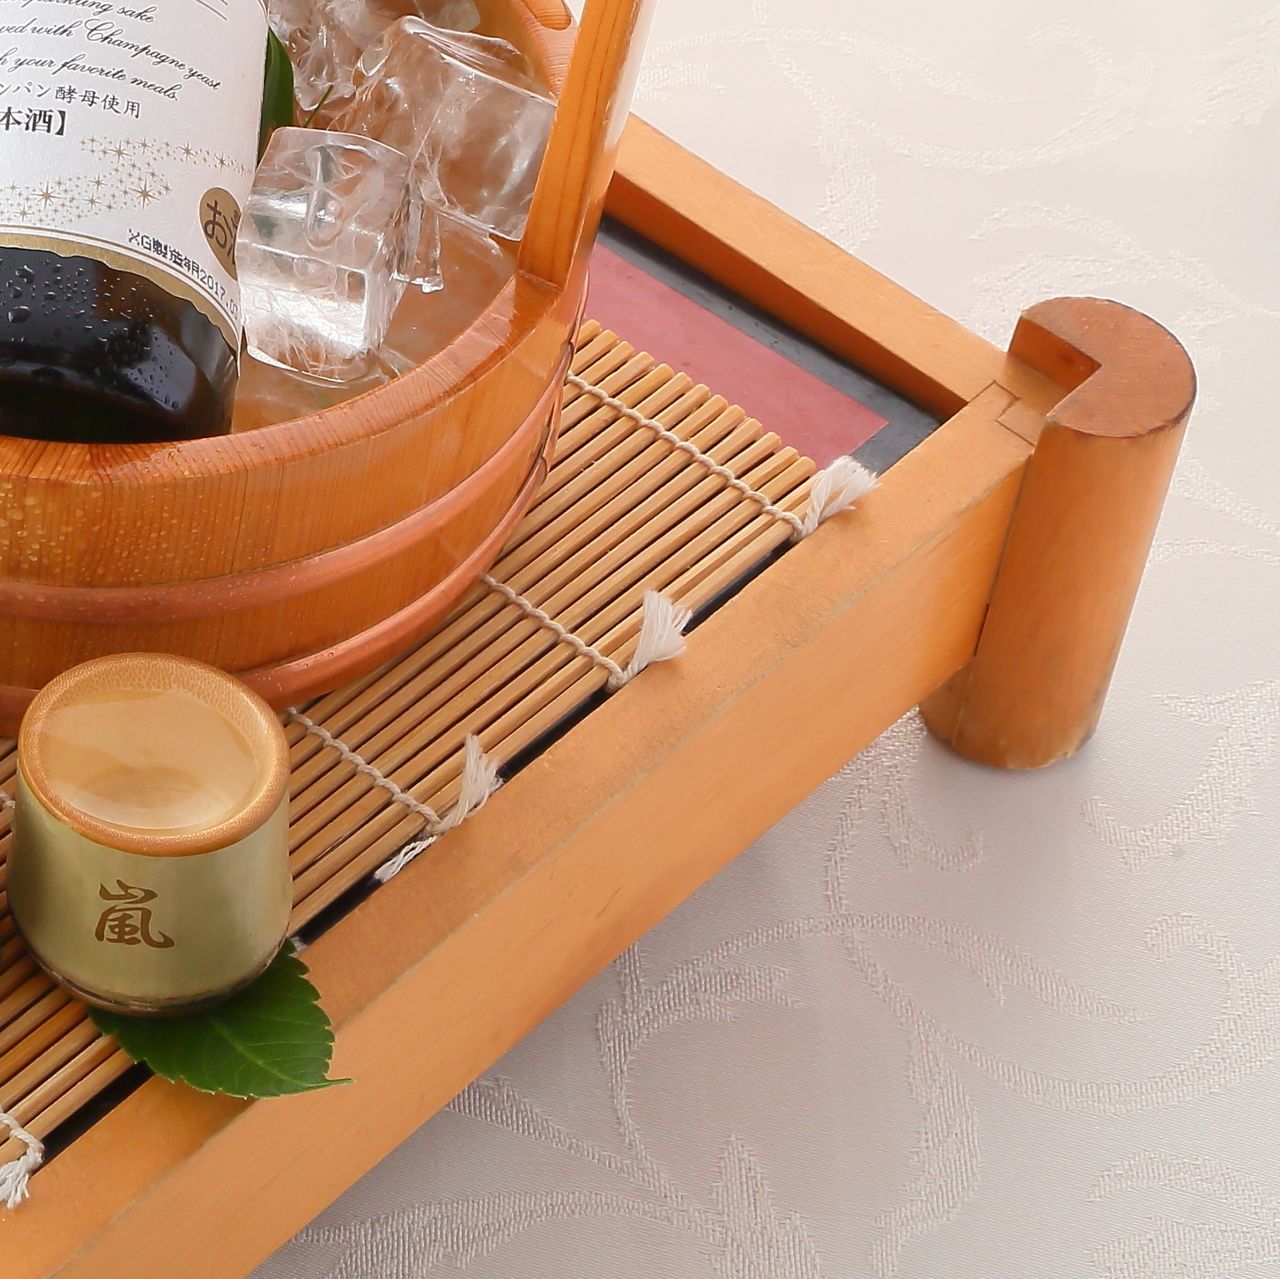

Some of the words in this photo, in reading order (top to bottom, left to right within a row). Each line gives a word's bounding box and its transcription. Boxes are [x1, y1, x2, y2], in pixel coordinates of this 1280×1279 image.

[116, 6, 157, 23] sake
[7, 58, 57, 73] your
[52, 53, 127, 81] favorite
[129, 83, 183, 102] meals.
[30, 20, 83, 38] with
[84, 18, 186, 70] Champagne
[183, 66, 222, 91] yeast
[93, 878, 176, 950] 嵐
